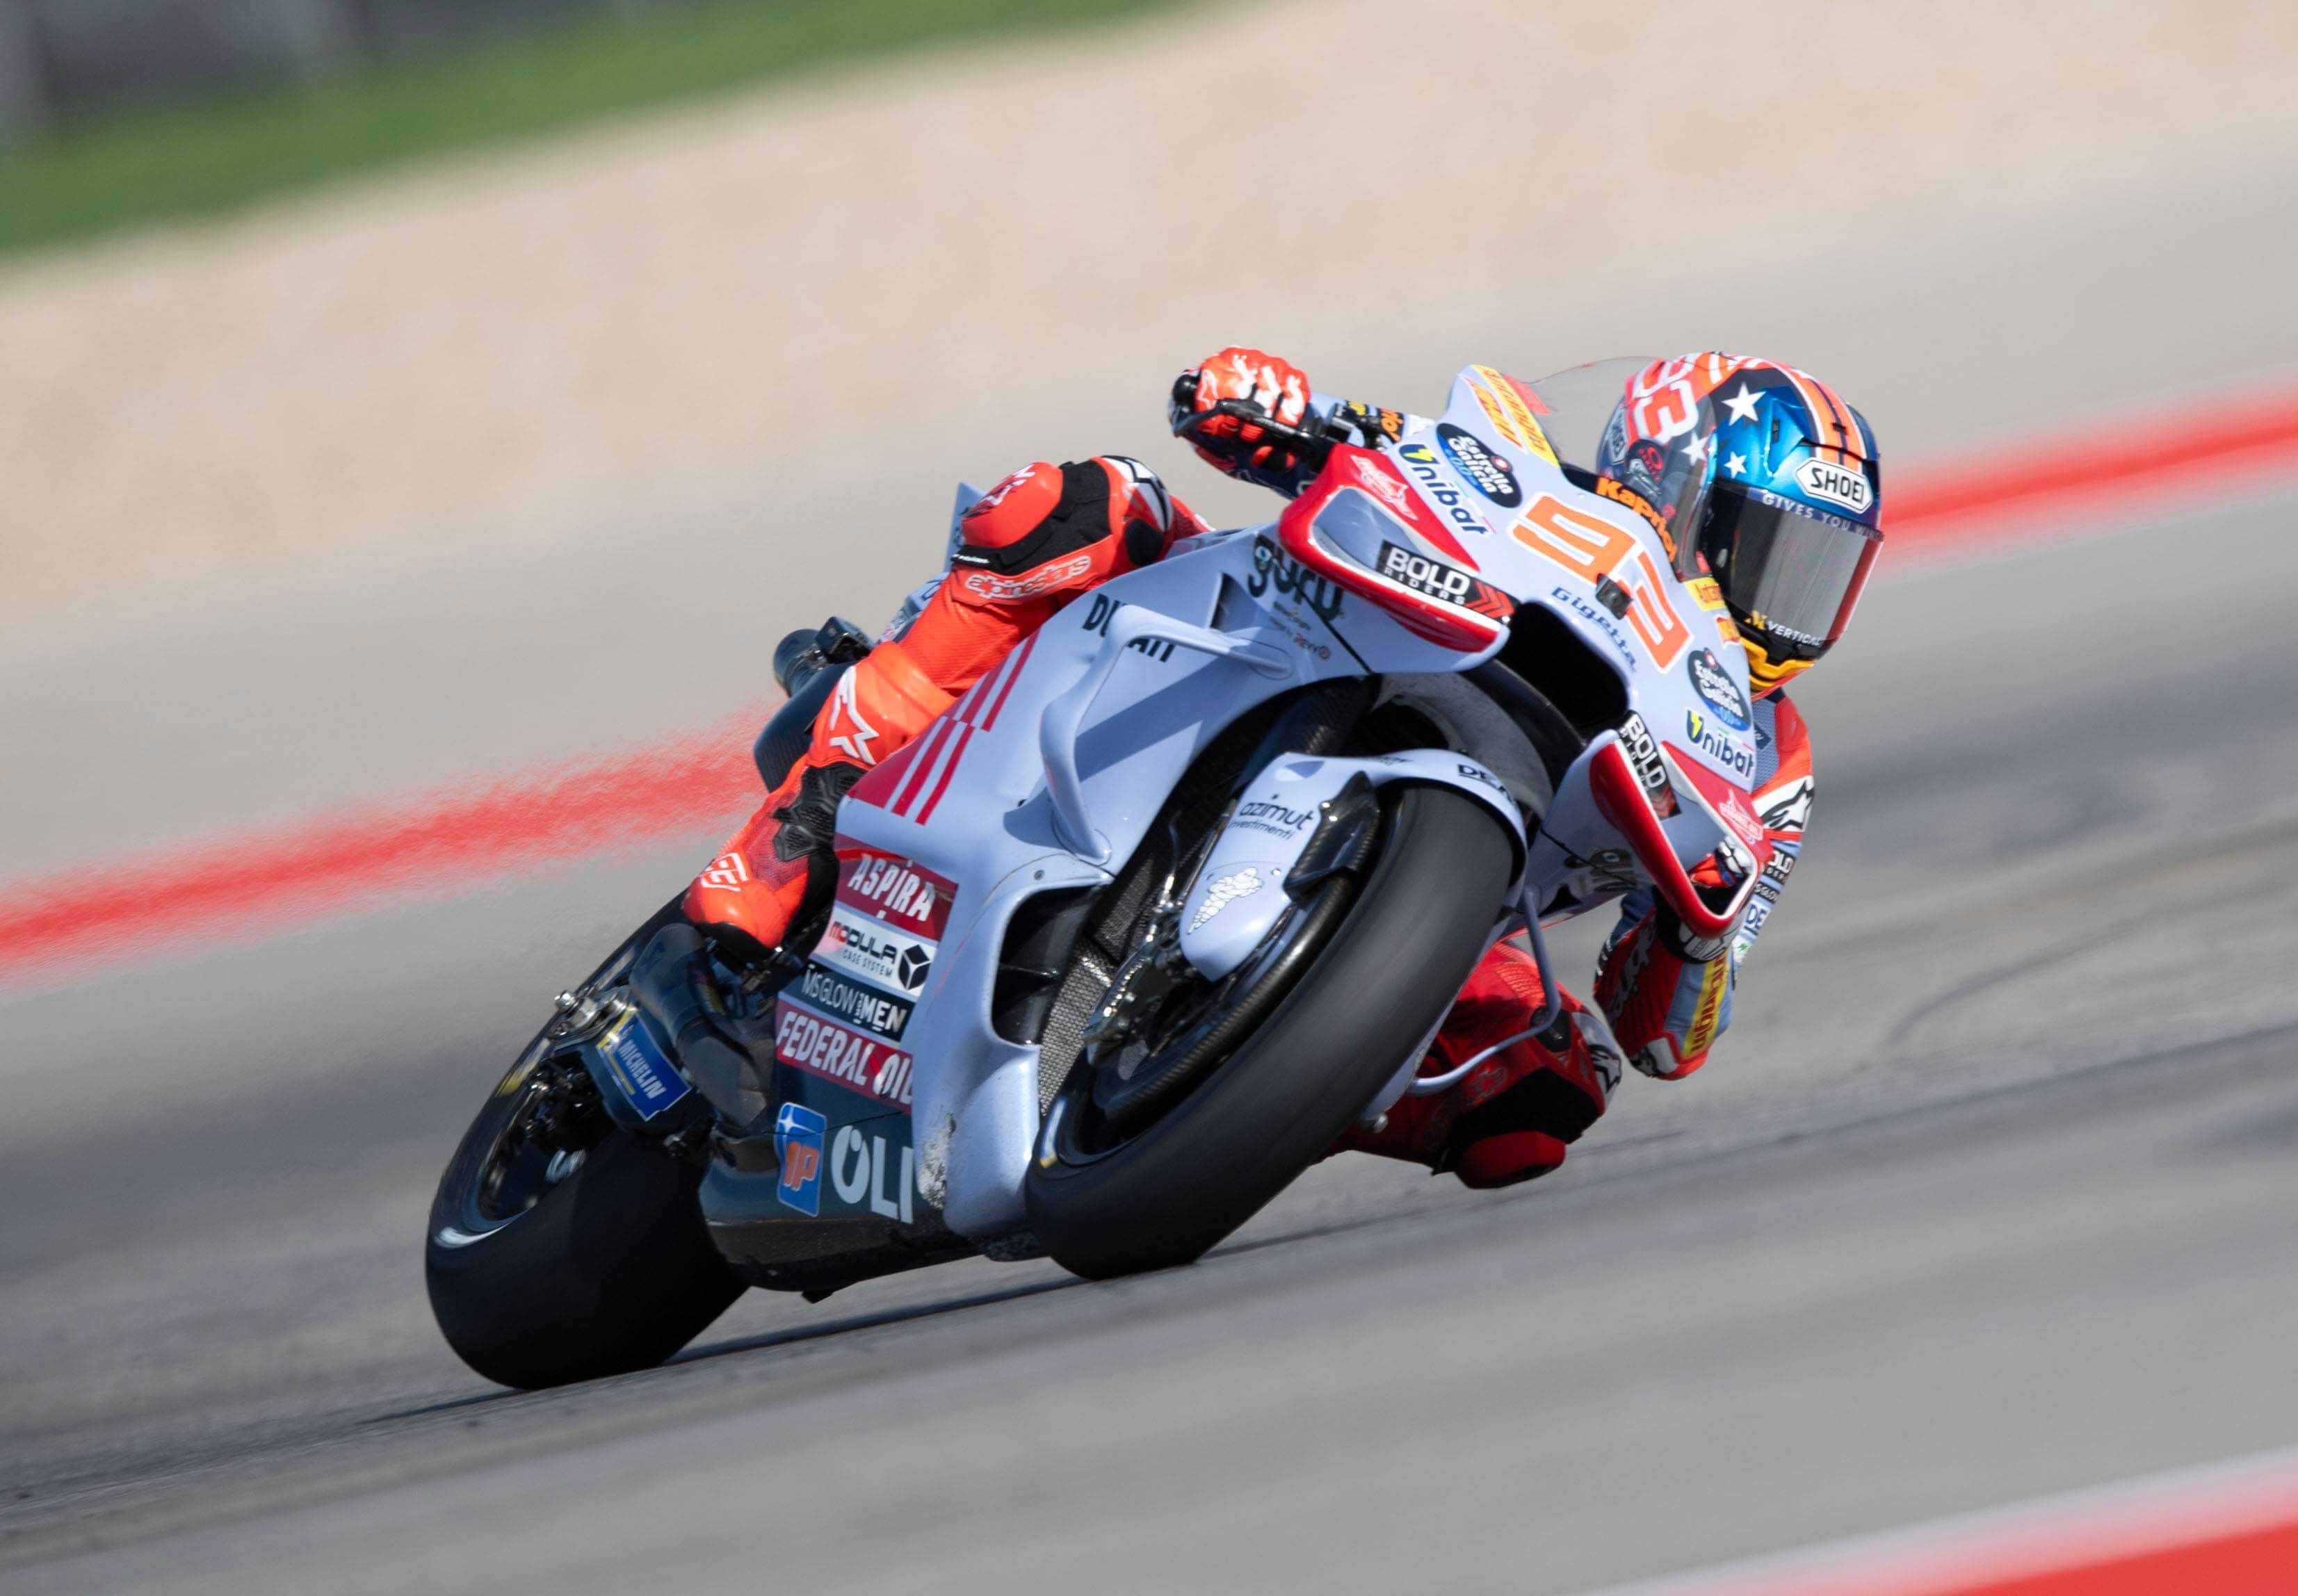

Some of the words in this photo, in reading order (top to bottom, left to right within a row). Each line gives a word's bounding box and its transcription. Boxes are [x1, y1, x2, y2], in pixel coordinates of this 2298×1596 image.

[1398, 443, 1489, 534] Unibat
[1761, 491, 1814, 519] GIVES
[1821, 514, 1852, 531] YOU
[1811, 467, 1865, 505] SHOEI
[1384, 567, 1466, 605] RIDERS
[1386, 546, 1471, 596] BOLD
[1510, 491, 1692, 673] 93
[1766, 620, 1822, 647] VERTICAL
[1625, 713, 1667, 788] BOLD
[1687, 710, 1754, 777] Unibat
[1239, 793, 1314, 831] azimut
[859, 993, 907, 1032] MEN
[618, 1039, 667, 1099] MICHELIN
[775, 1010, 876, 1086] FEDERAL
